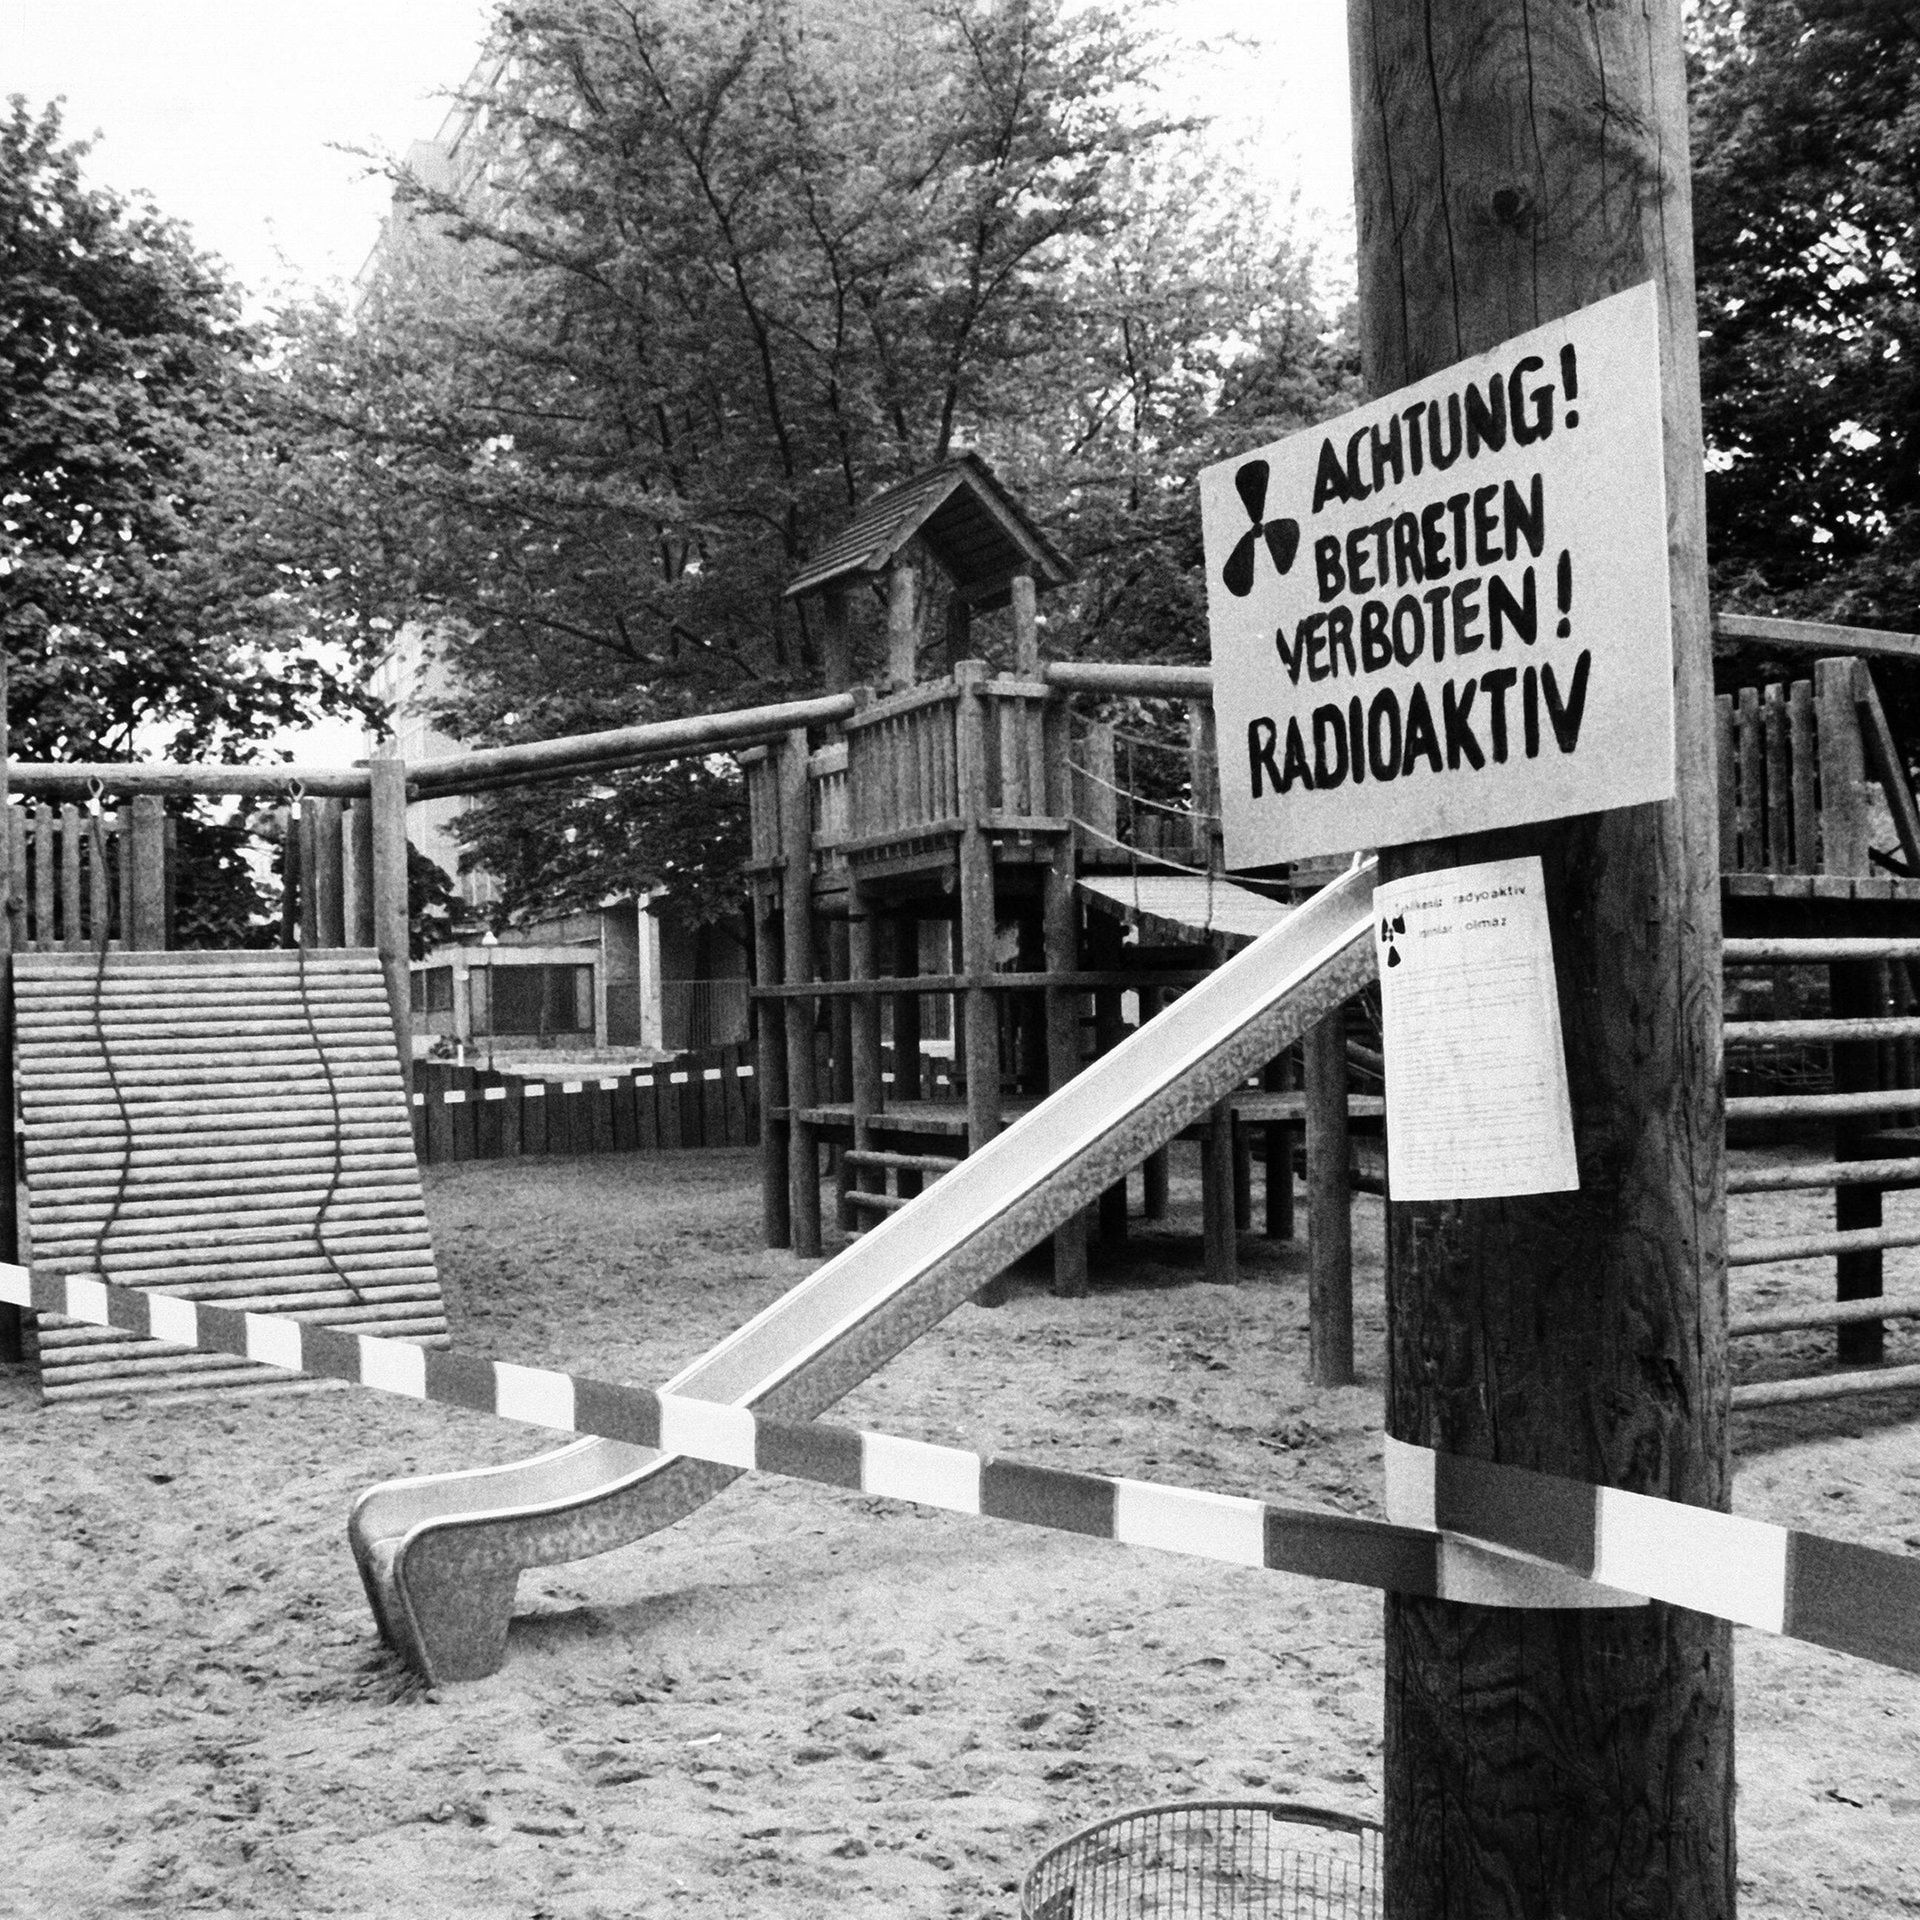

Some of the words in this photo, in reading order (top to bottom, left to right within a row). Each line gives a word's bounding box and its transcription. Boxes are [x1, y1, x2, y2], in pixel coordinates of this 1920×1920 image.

[1312, 343, 1579, 514] ACHTUNG!
[1315, 473, 1544, 603] BETRETEN
[1248, 649, 1591, 799] RADIOAKTIV
[1454, 886, 1526, 903] radyoaktiv
[1465, 917, 1507, 930] olmaz
